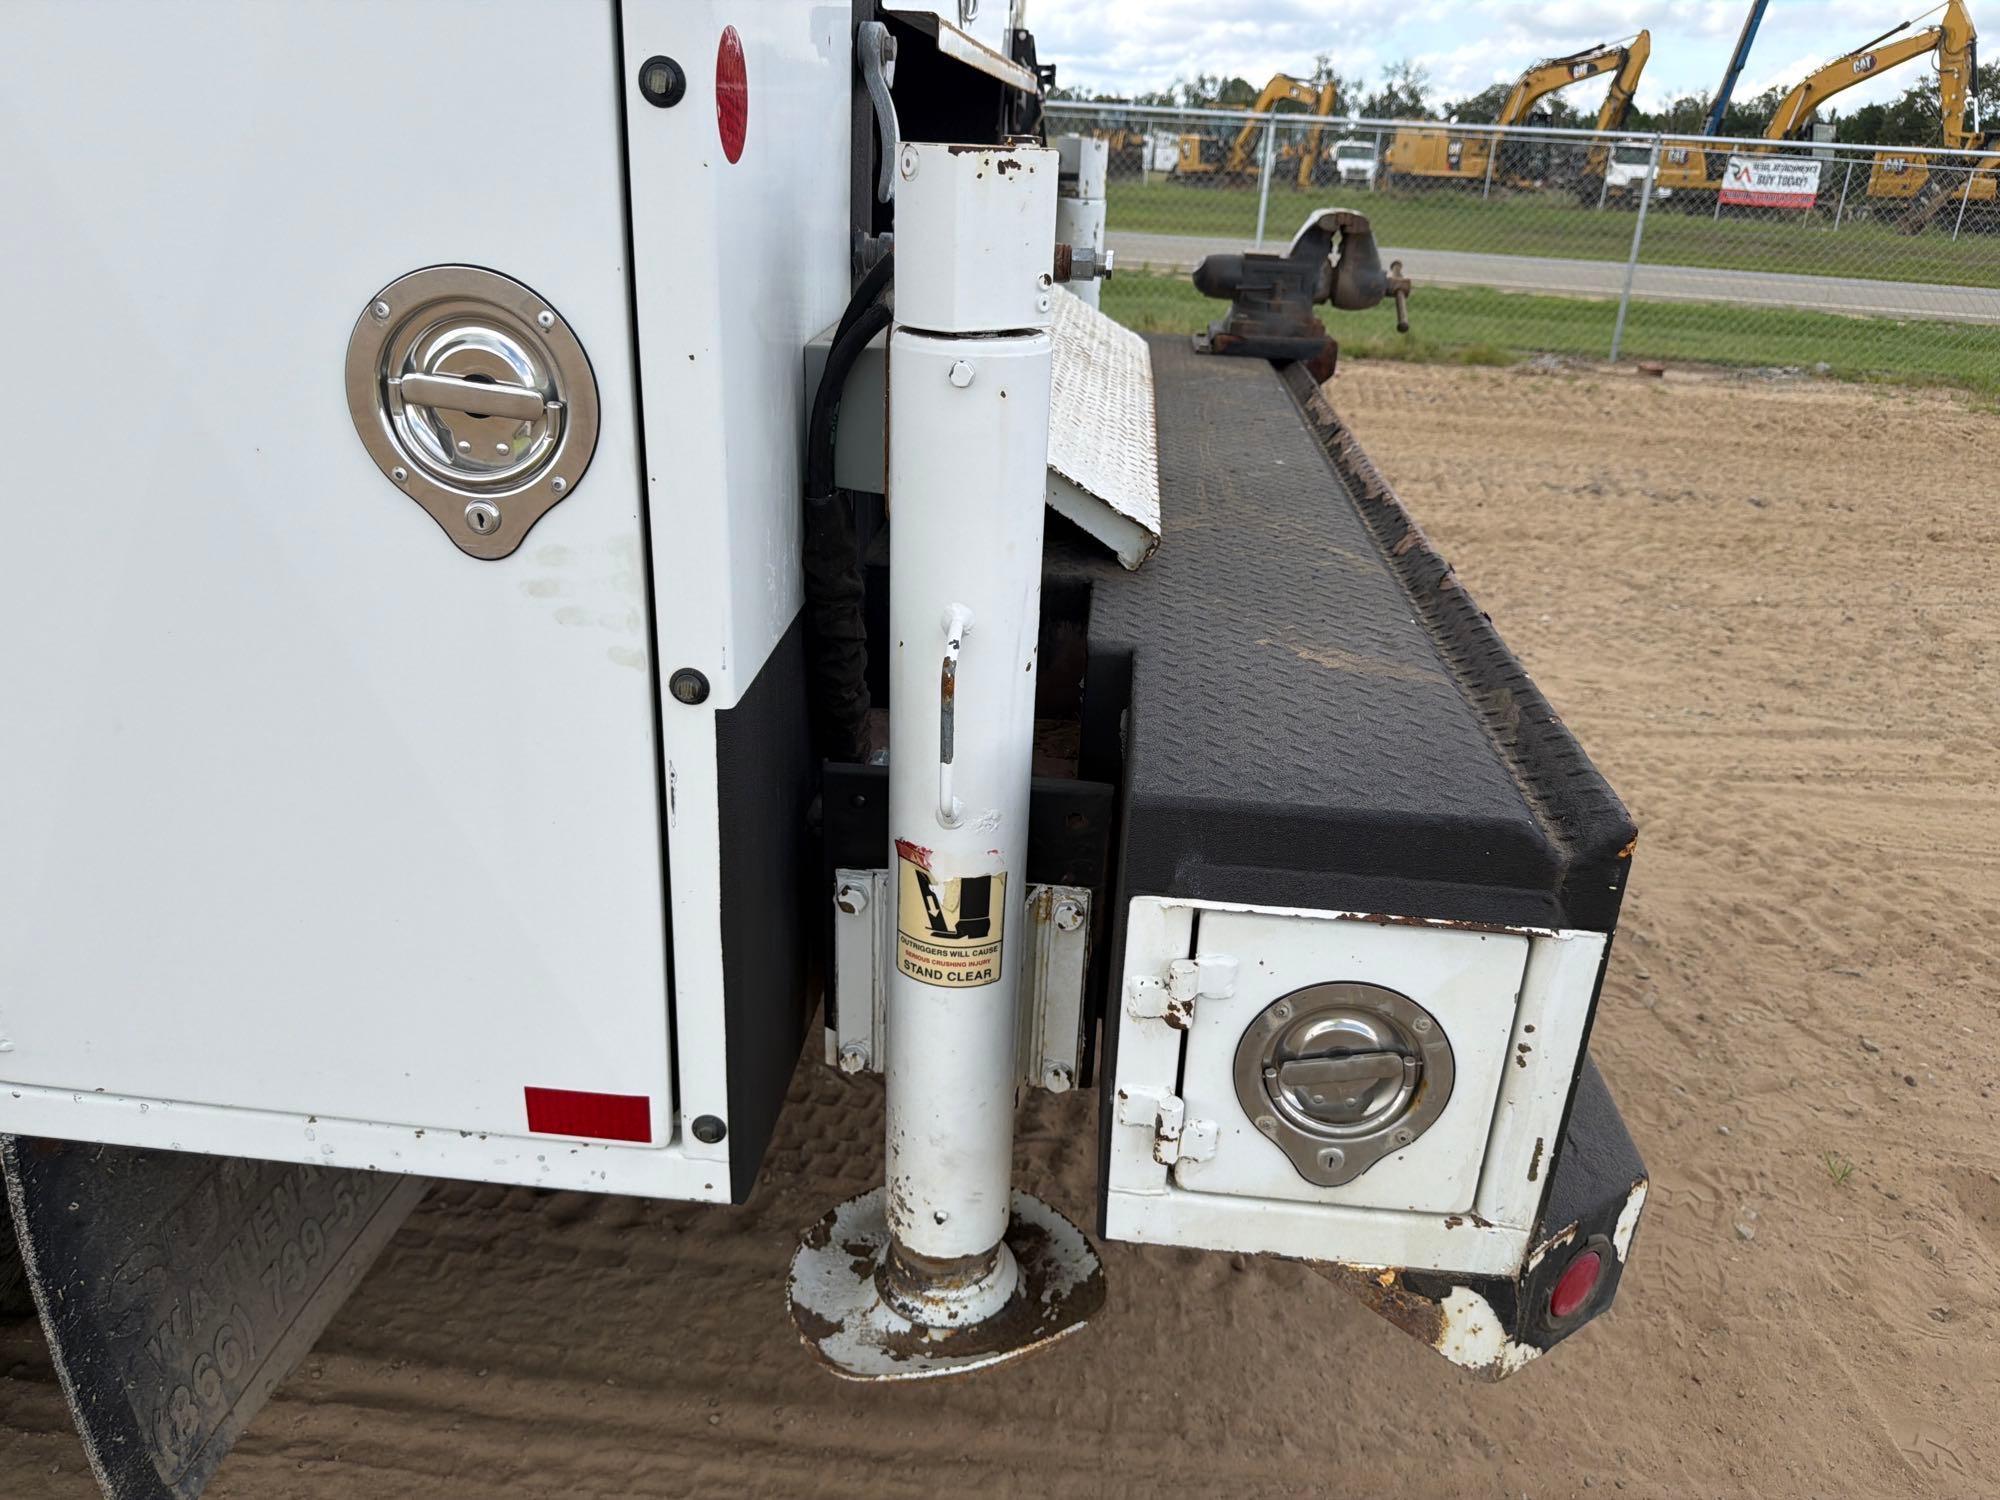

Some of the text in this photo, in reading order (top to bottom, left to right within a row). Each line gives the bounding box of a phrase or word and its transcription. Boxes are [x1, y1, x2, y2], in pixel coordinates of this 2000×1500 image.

[1853, 54, 1872, 74] CAT
[1757, 174, 1776, 186] BUY
[900, 935, 999, 958] OUTRIGGERS WILL CAUSE
[905, 949, 992, 968] SERIOUS CRUSHING INJURY
[903, 959, 992, 982] STAND CLEAR
